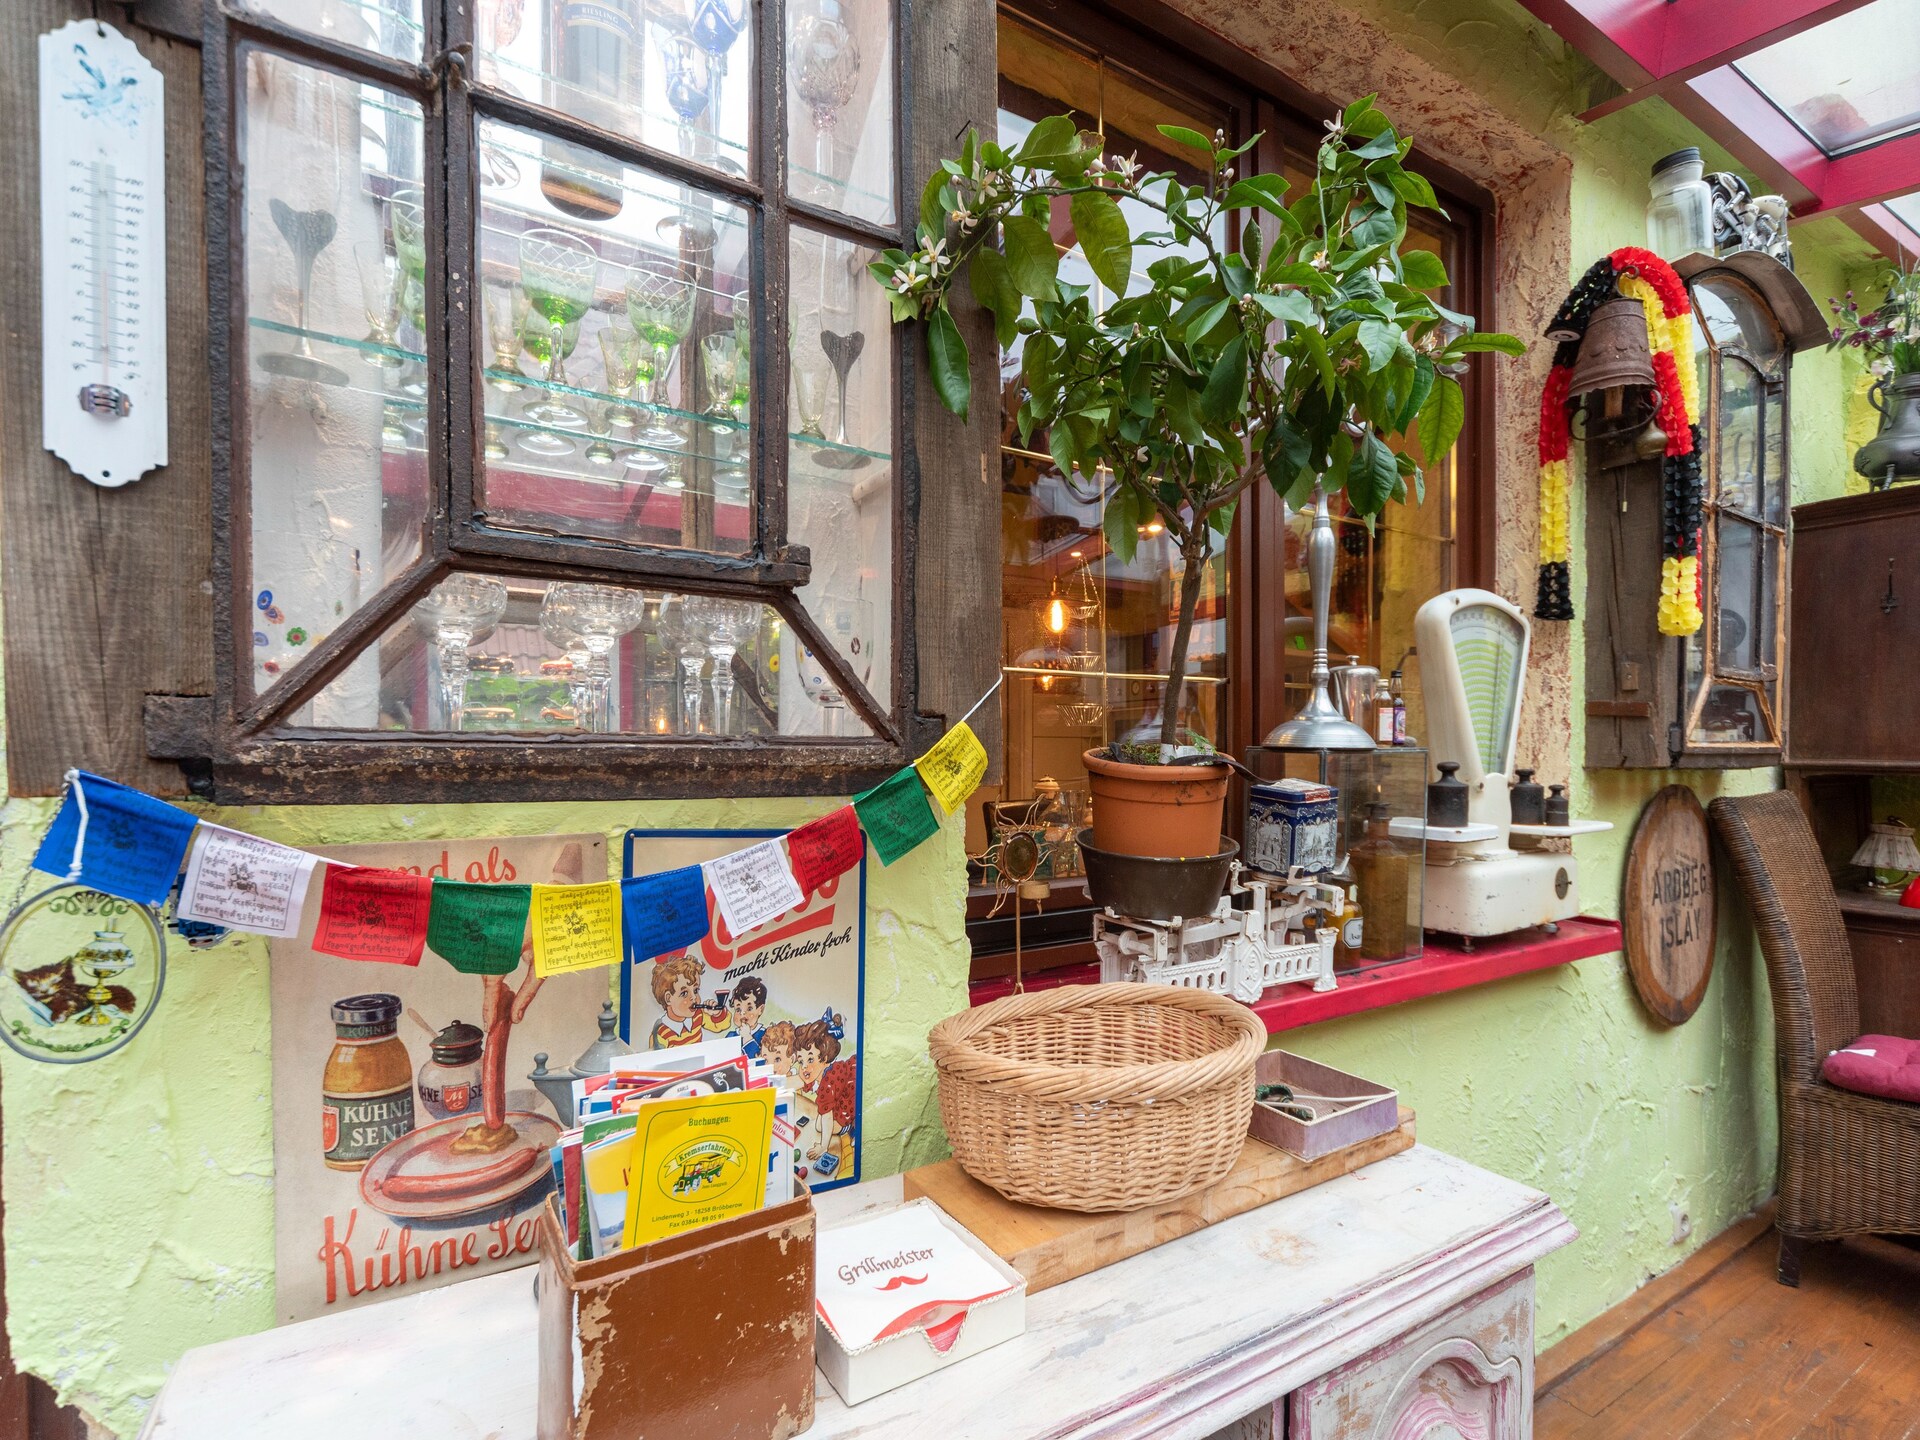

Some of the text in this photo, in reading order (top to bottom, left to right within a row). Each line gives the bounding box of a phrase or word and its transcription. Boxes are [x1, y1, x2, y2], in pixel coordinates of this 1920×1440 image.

[581, 7, 619, 23] RIESLING
[464, 846, 517, 883] als
[1652, 863, 1706, 906] ARDBEG
[1660, 908, 1700, 948] ISLAY
[723, 926, 852, 983] macht Kinder froh
[343, 1097, 412, 1123] KÜHNE
[688, 1116, 731, 1127] Buchungen:
[679, 1143, 731, 1161] Kremserfahrten
[651, 1212, 685, 1222] Lindenweg
[694, 1207, 711, 1215] 18258
[319, 1208, 480, 1303] Kühne
[838, 1248, 934, 1285] Grillmeister
